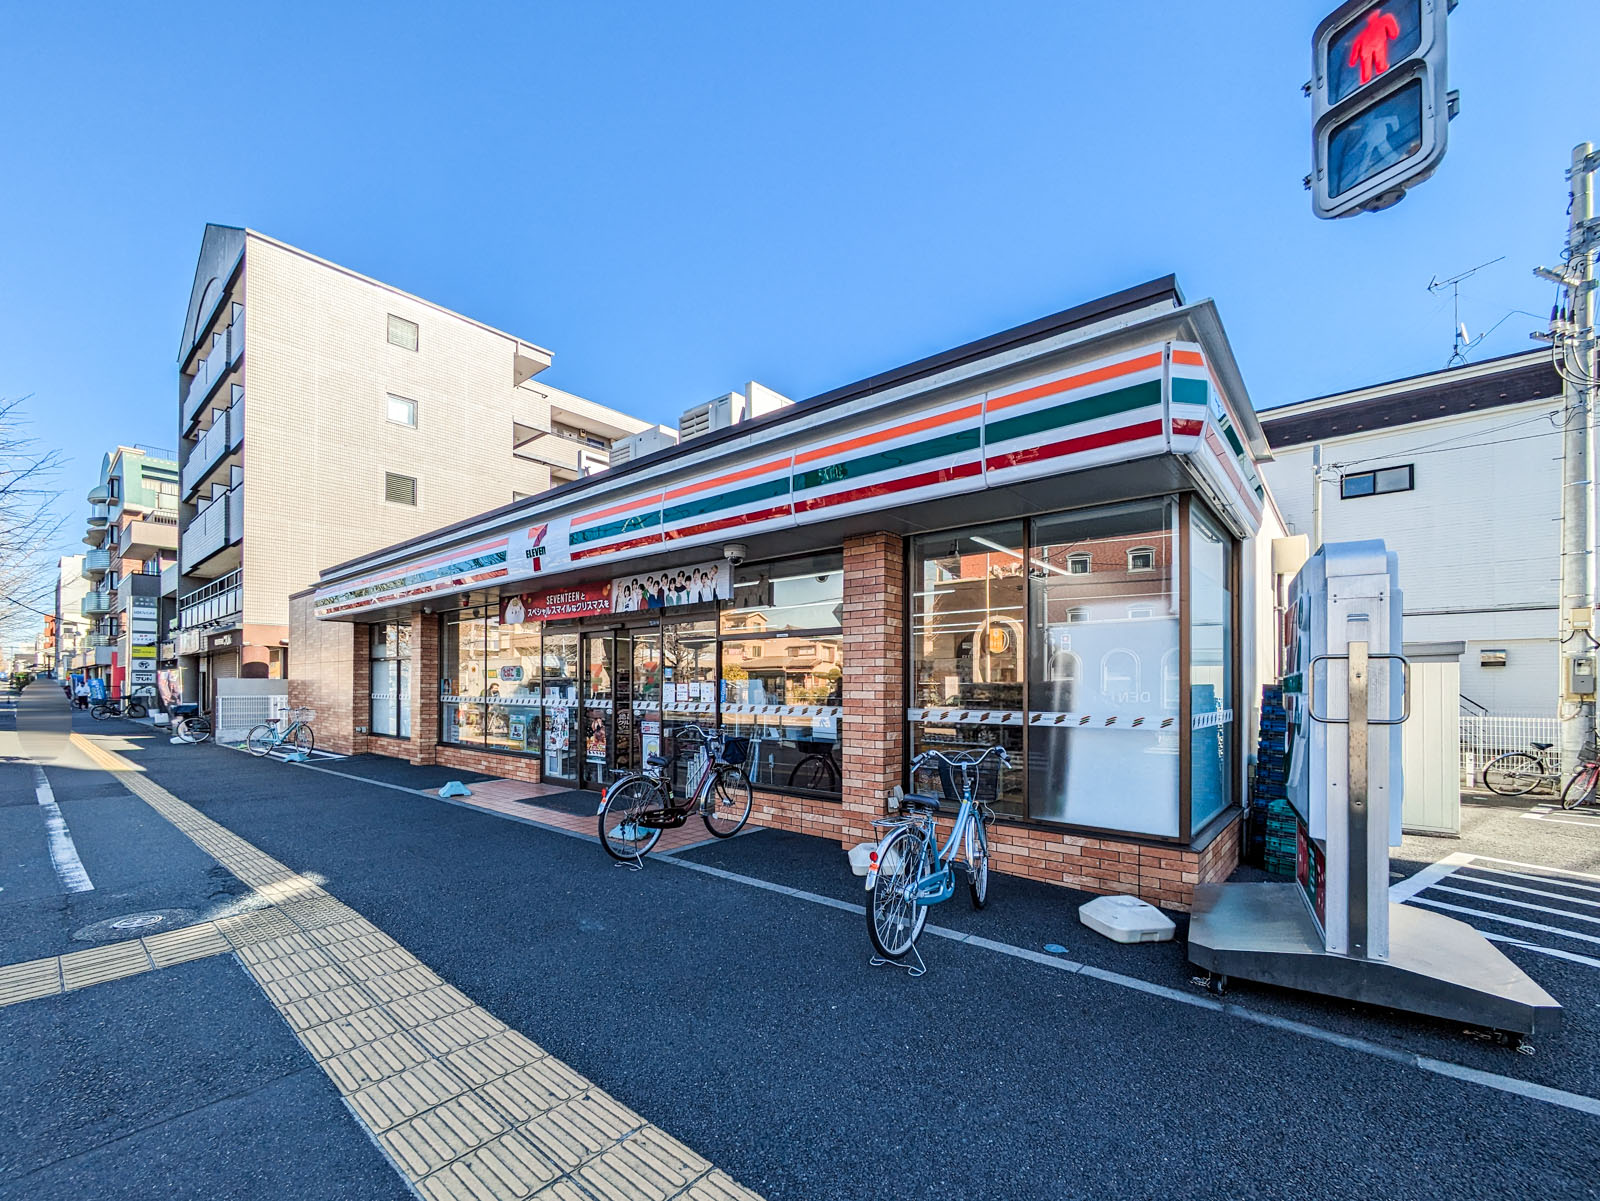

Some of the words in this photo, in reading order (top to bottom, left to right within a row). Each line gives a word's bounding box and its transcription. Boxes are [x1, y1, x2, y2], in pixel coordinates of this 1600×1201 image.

[527, 599, 610, 617] スペシャルスマイルなクリスマスを
